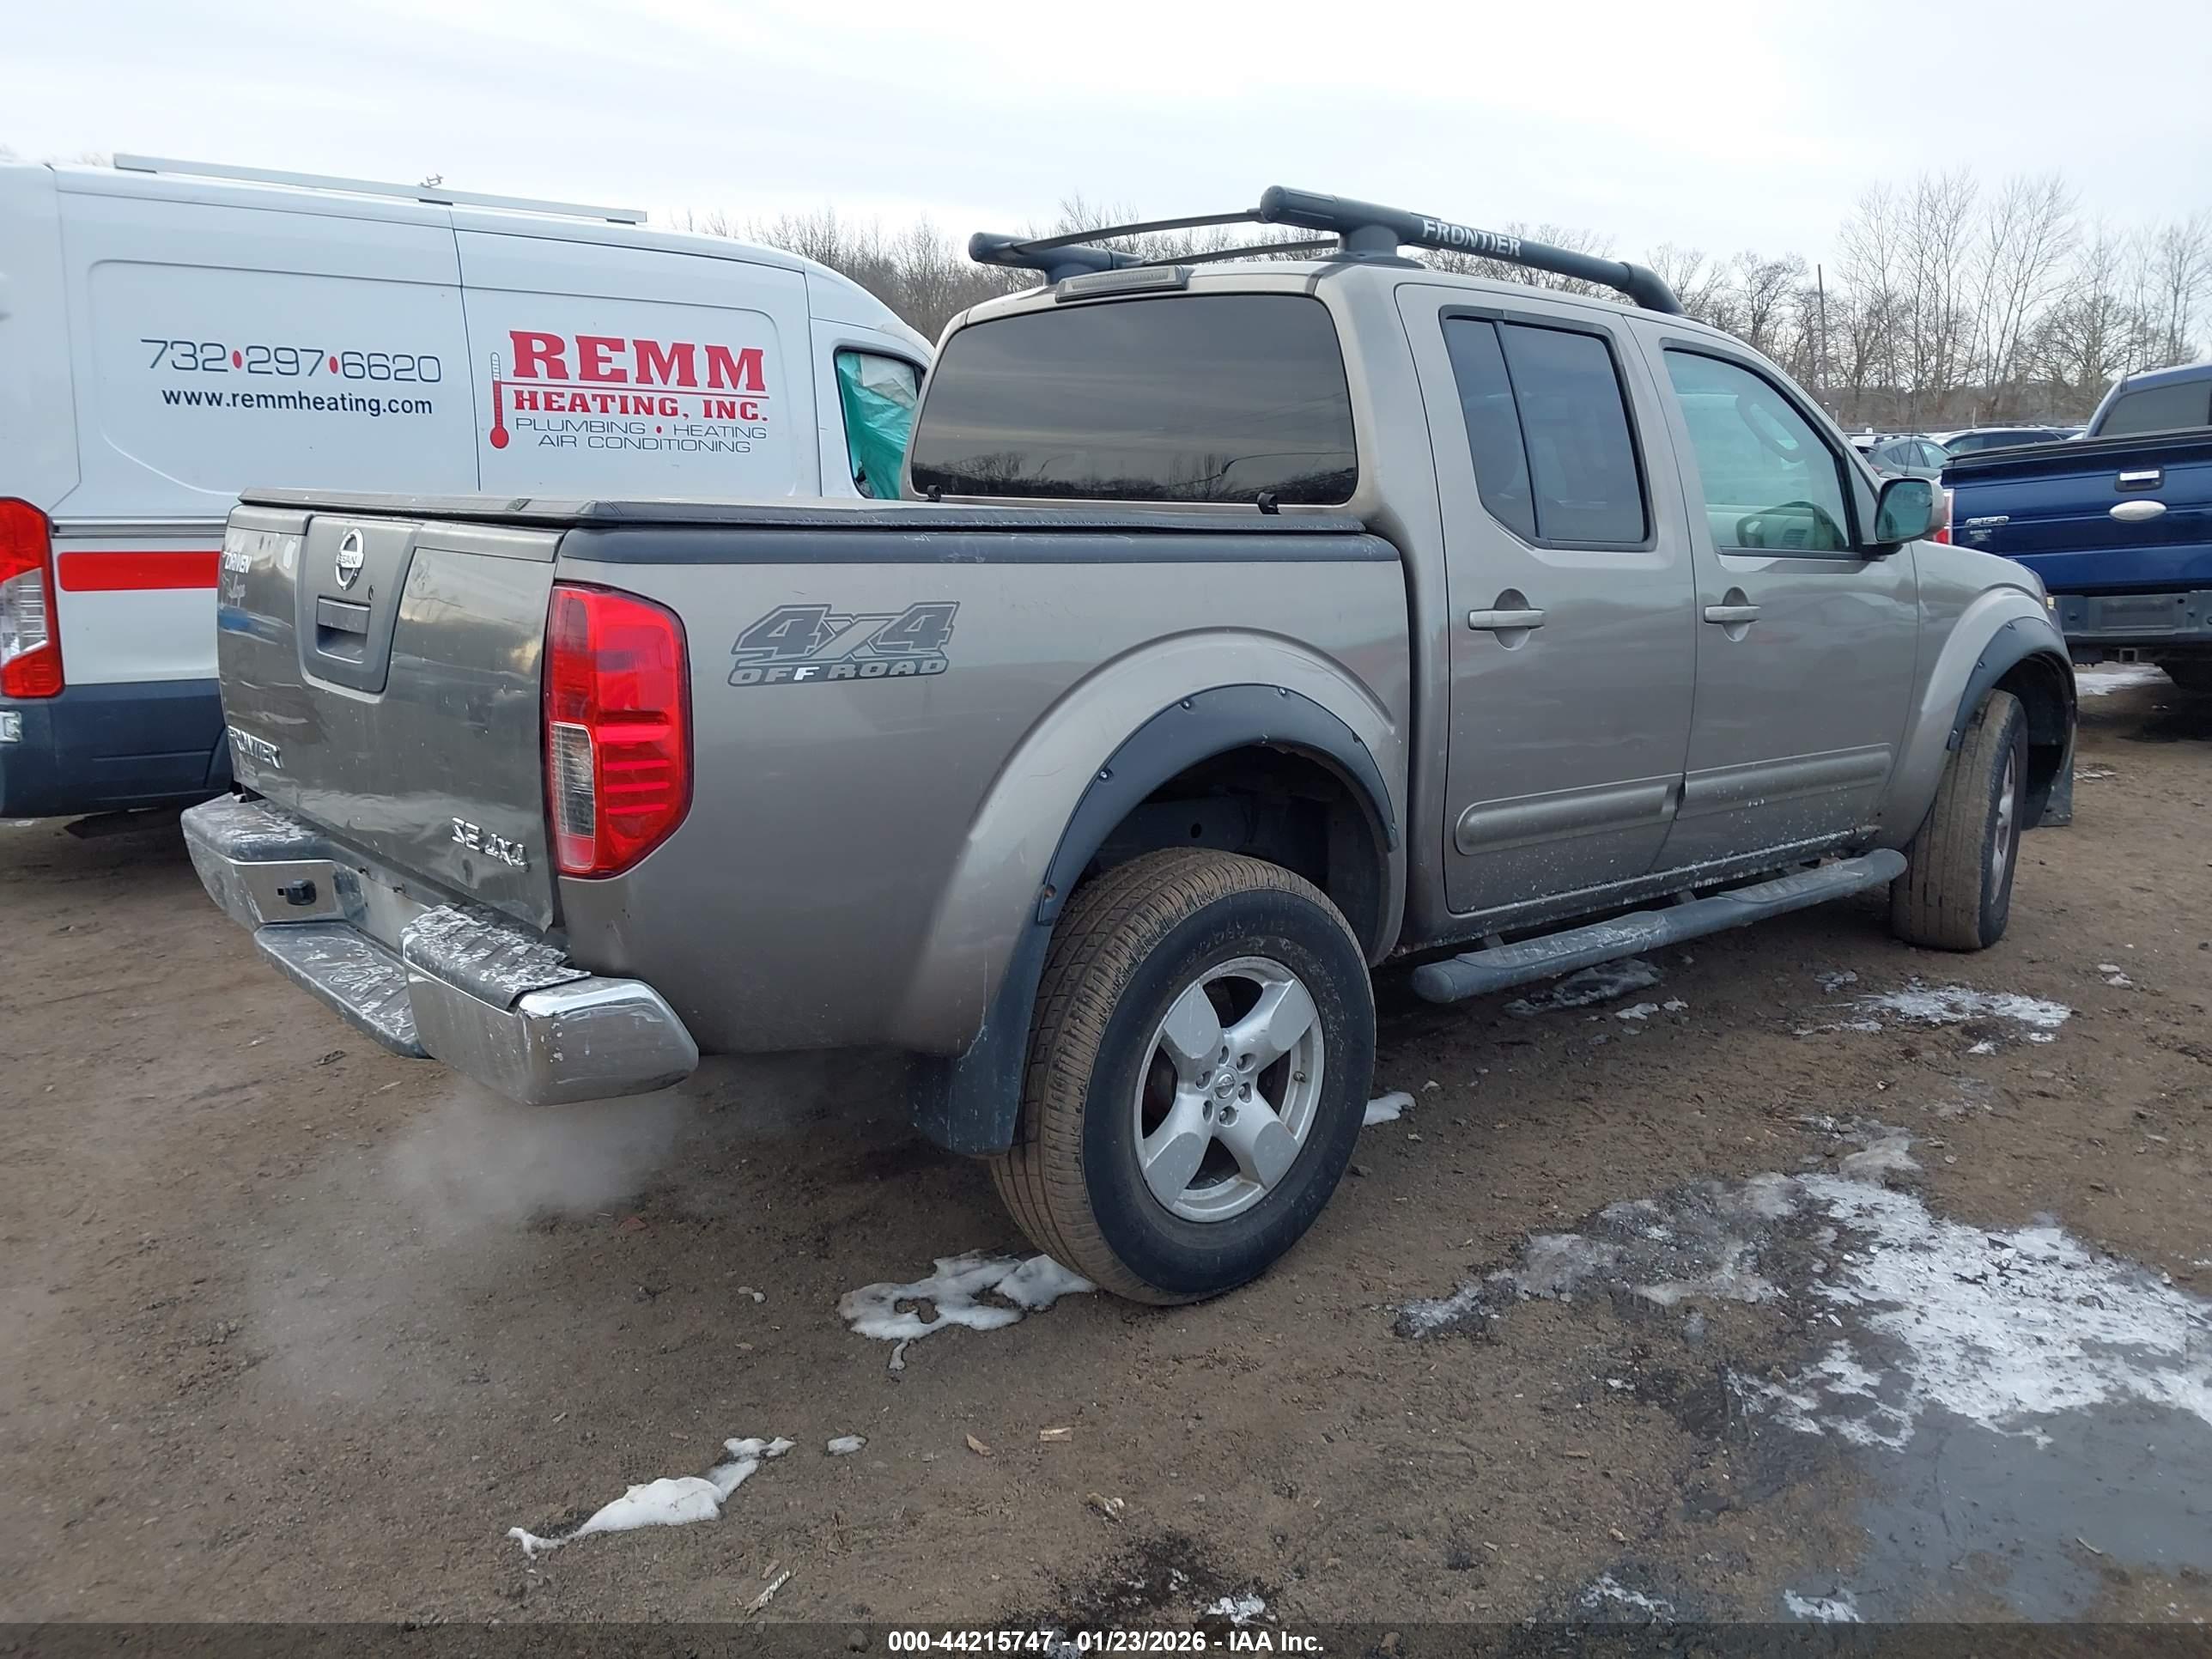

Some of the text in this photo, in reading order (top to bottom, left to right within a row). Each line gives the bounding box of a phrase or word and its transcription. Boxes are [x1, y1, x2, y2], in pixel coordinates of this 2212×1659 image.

[1422, 219, 1521, 257] FRONTIER
[509, 330, 766, 392] REMM
[161, 389, 433, 417] www.remmheating.com
[514, 390, 769, 422] HEATING, INC.
[515, 417, 768, 440] PLUMBING HEATING
[538, 434, 751, 453] AIR CONDITIONING
[729, 659, 948, 685] OFF ROAD
[452, 817, 481, 851] SE
